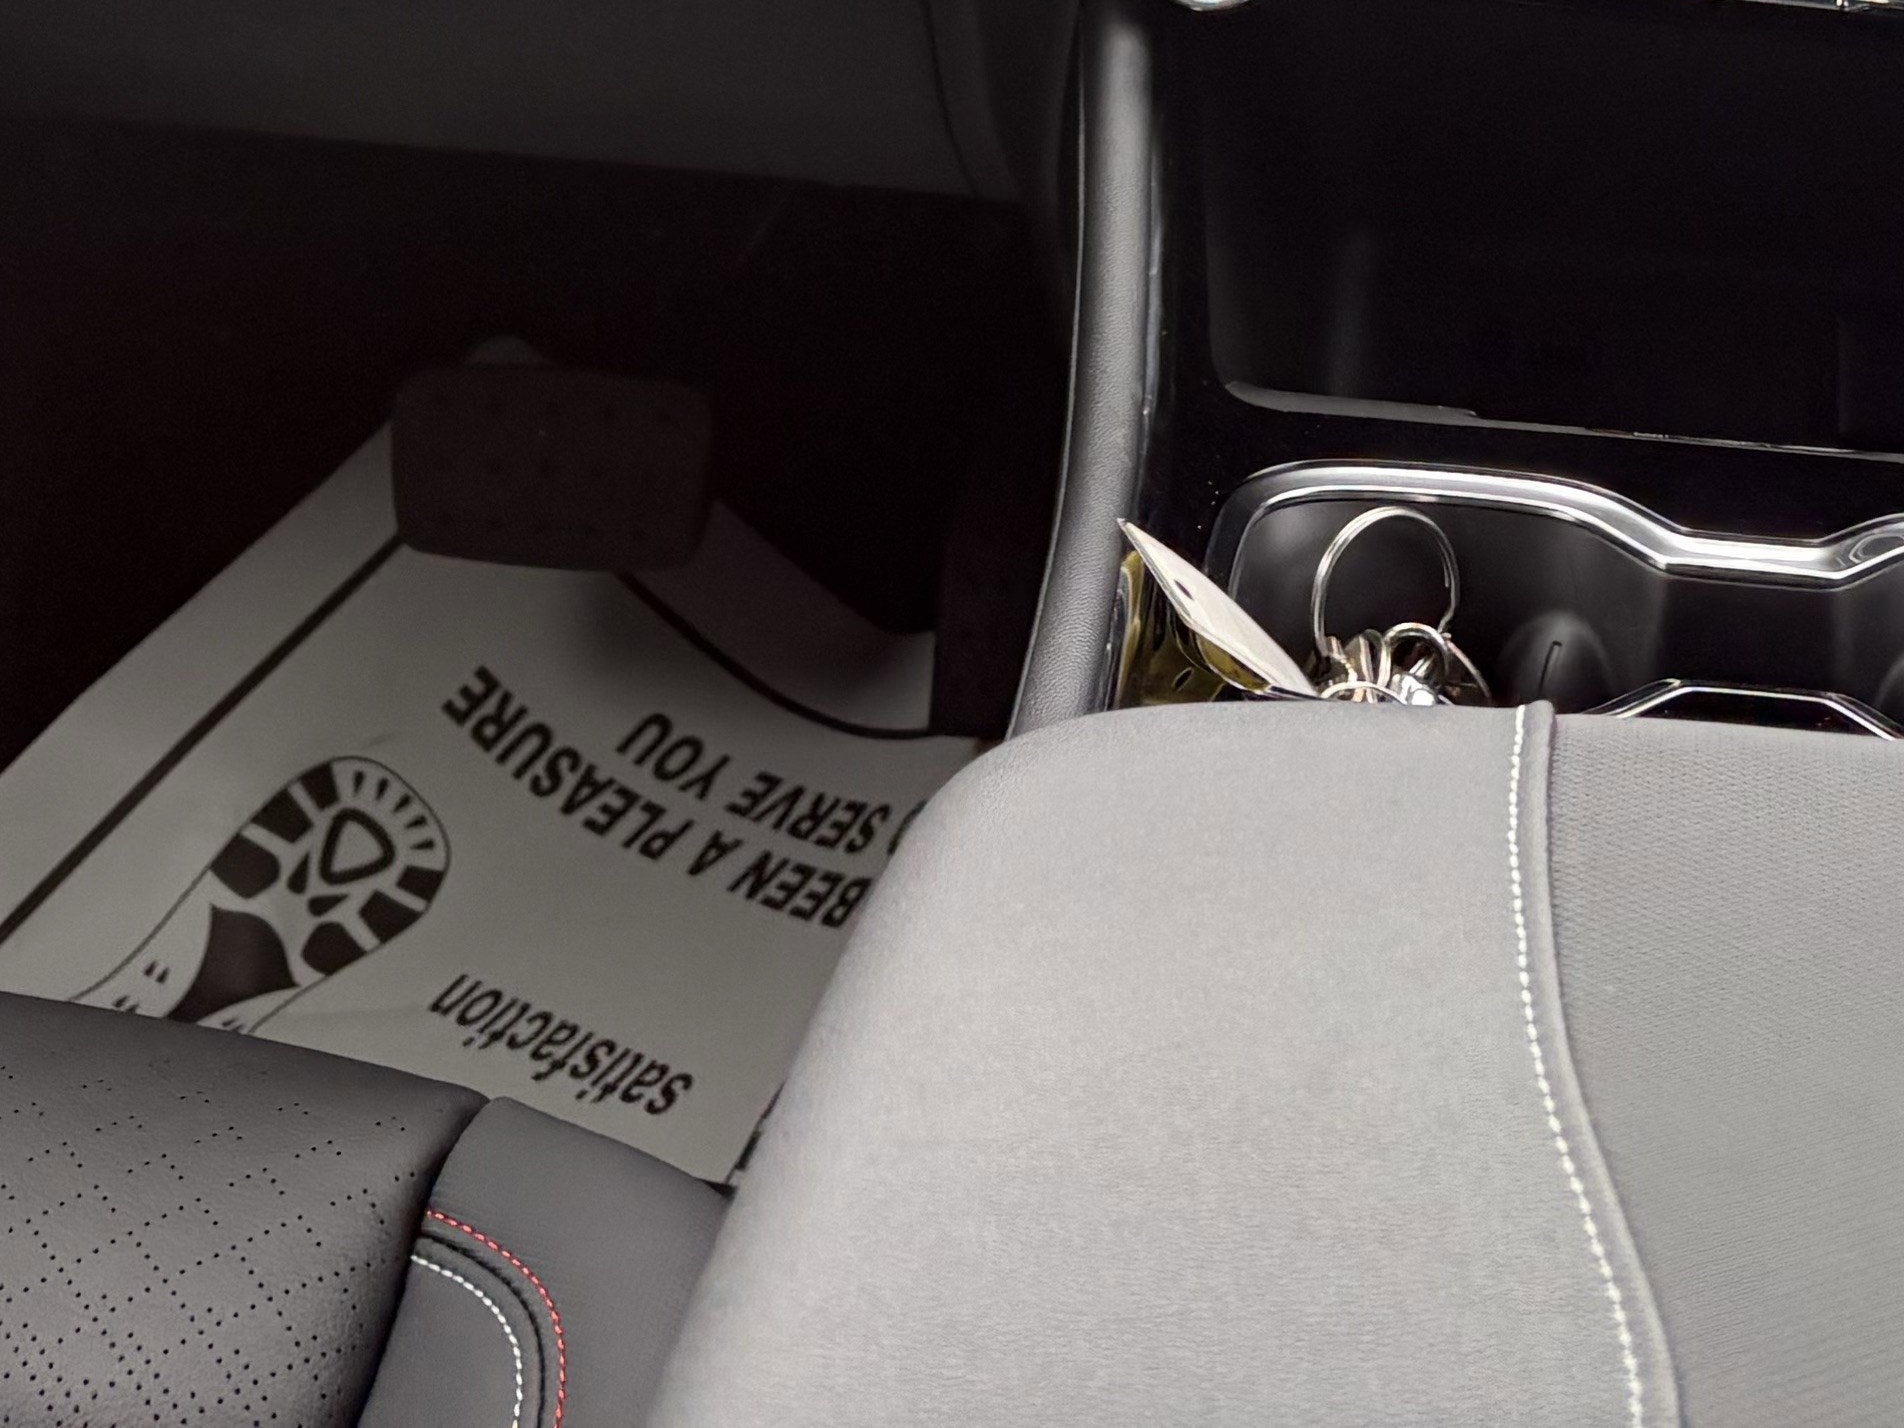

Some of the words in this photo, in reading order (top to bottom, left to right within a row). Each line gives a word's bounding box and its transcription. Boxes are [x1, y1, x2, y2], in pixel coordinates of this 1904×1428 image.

[441, 664, 694, 860] PLEASURE
[615, 712, 731, 798] YOU
[687, 831, 743, 877] A
[725, 772, 893, 855] SERVE
[727, 851, 874, 928] BEEN
[429, 974, 694, 1116] satisfaction
